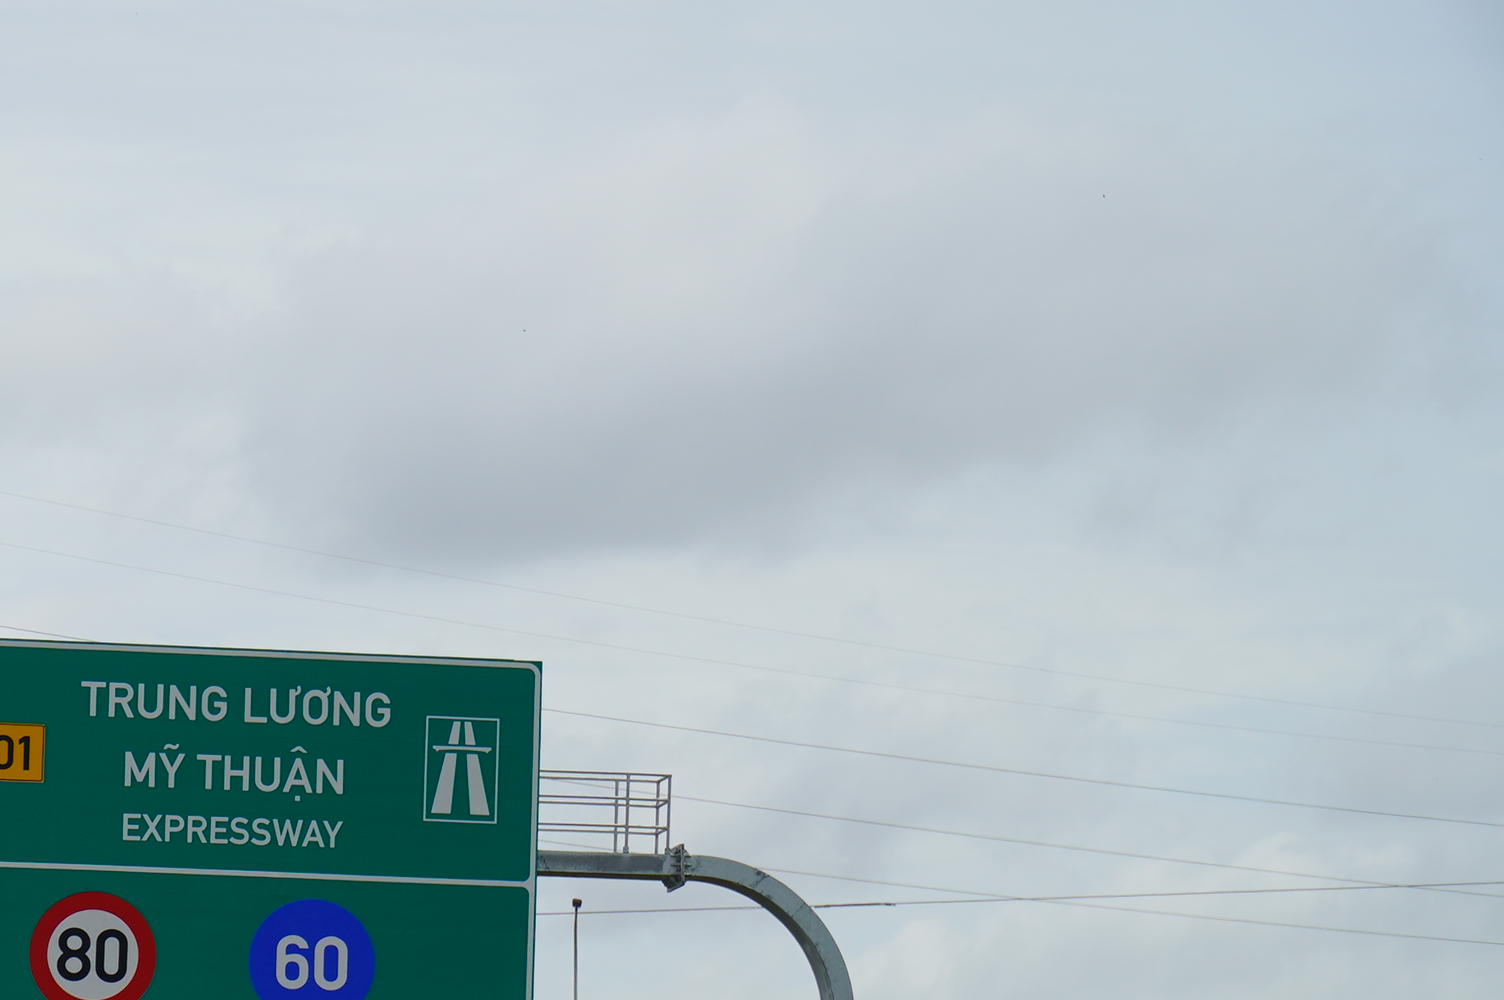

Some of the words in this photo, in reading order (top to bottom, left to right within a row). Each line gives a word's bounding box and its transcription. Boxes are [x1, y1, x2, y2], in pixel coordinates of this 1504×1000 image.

[81, 680, 229, 723] TRUNG
[244, 684, 392, 728] LƯƠNG
[123, 743, 186, 788] MỸ
[197, 745, 345, 802] THUẬN
[121, 813, 344, 849] EXPRESSWAY
[56, 926, 129, 984] 80
[274, 934, 349, 992] 60
